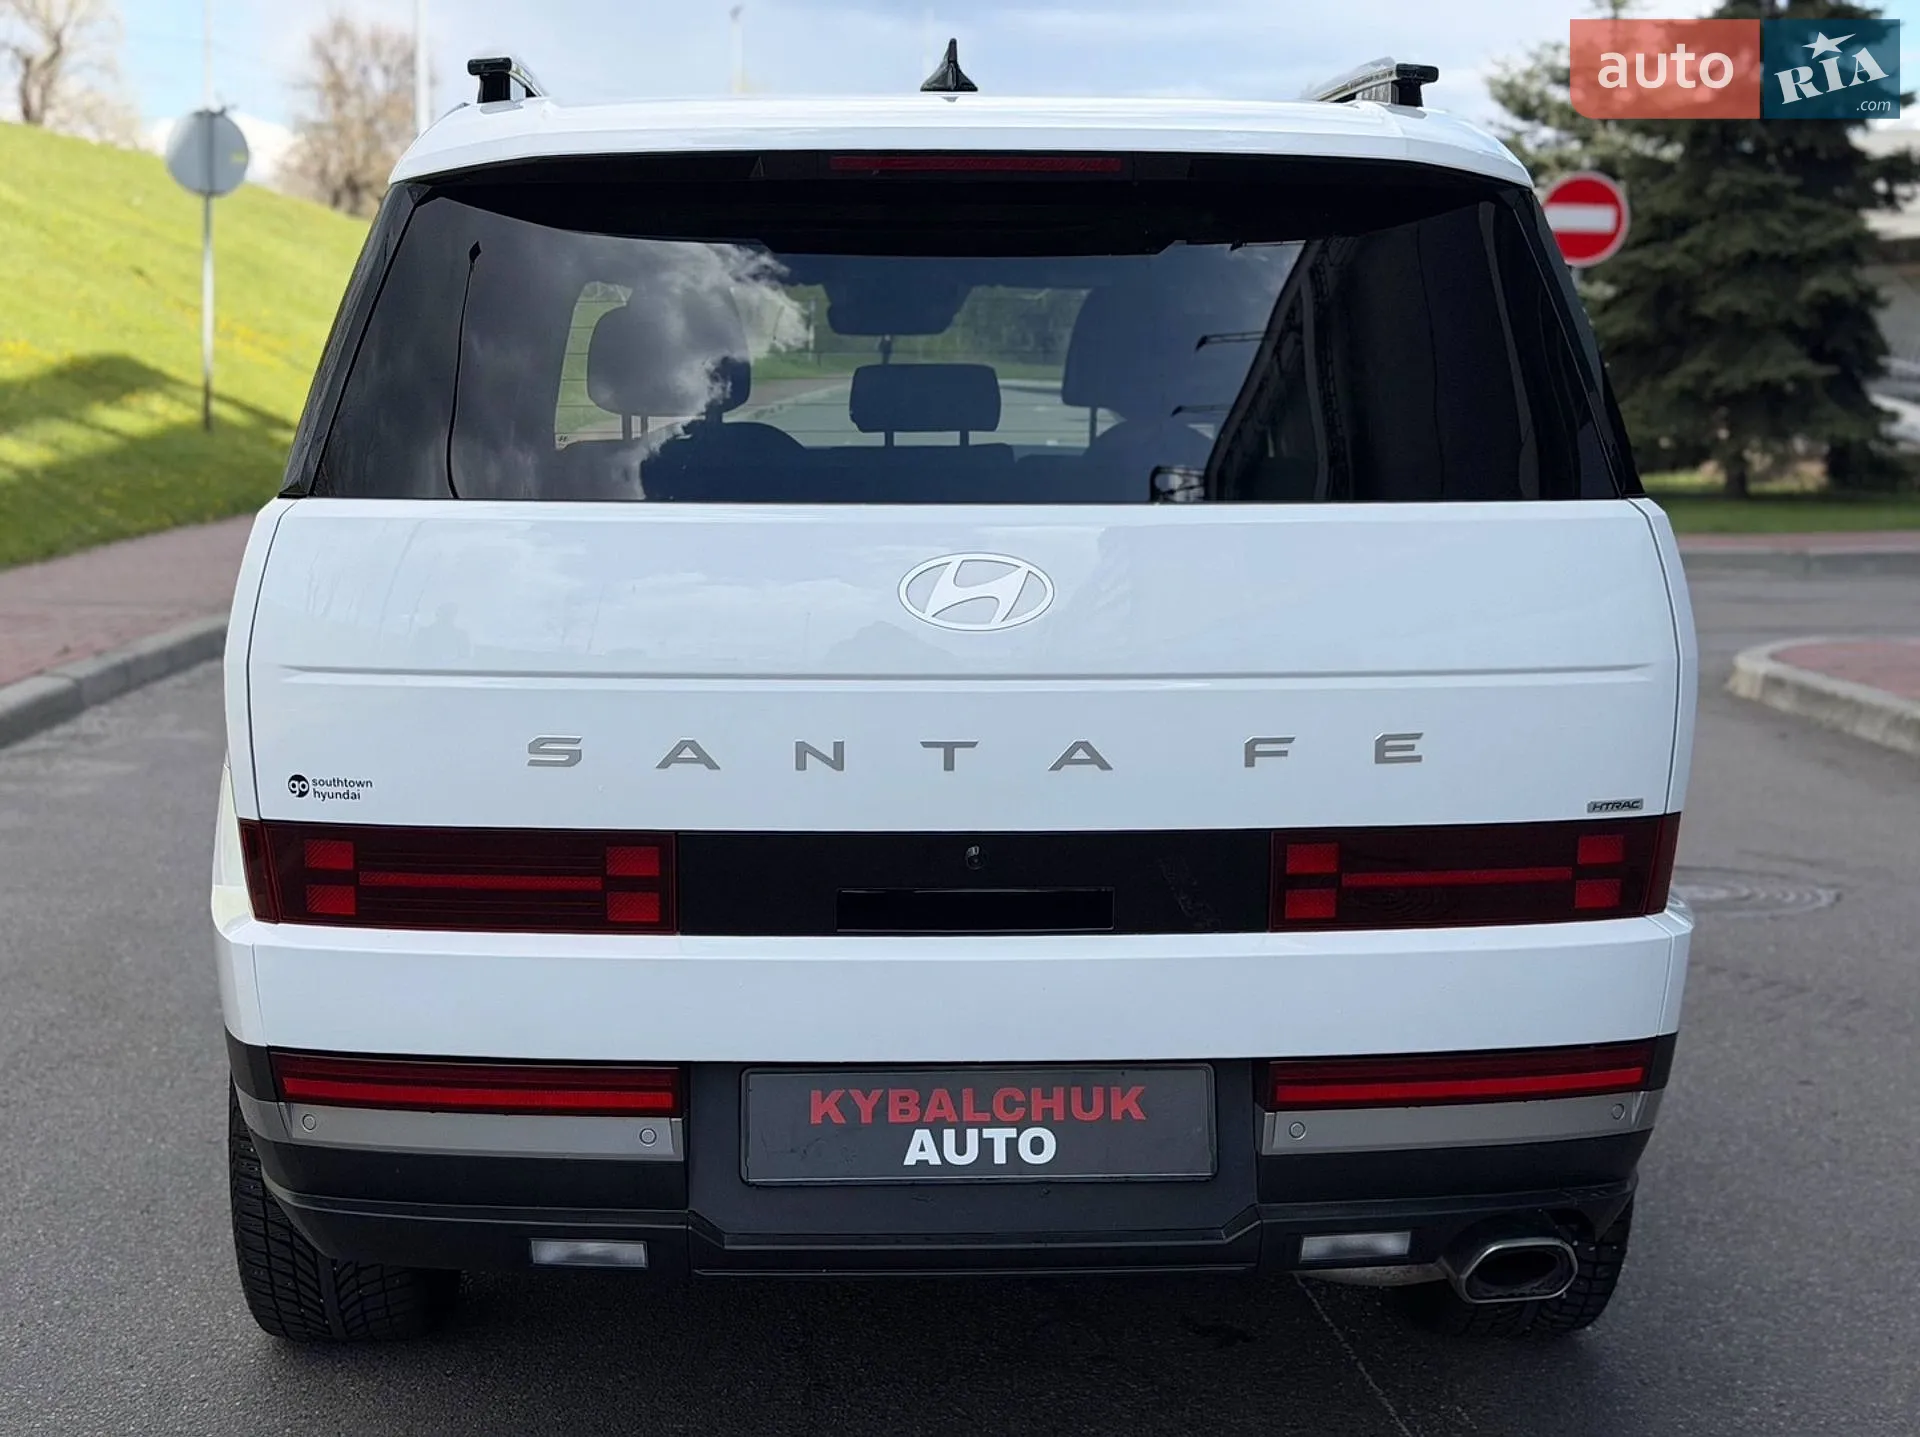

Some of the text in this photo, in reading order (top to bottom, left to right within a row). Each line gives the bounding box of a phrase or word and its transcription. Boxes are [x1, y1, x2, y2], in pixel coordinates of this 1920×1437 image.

[527, 732, 1424, 772] SANTA FE
[312, 777, 373, 788] southtown
[313, 788, 361, 801] hyundai
[1591, 800, 1641, 811] HTRAC
[810, 1086, 1147, 1124] KYBALCHUK
[903, 1127, 1057, 1165] AUTO
